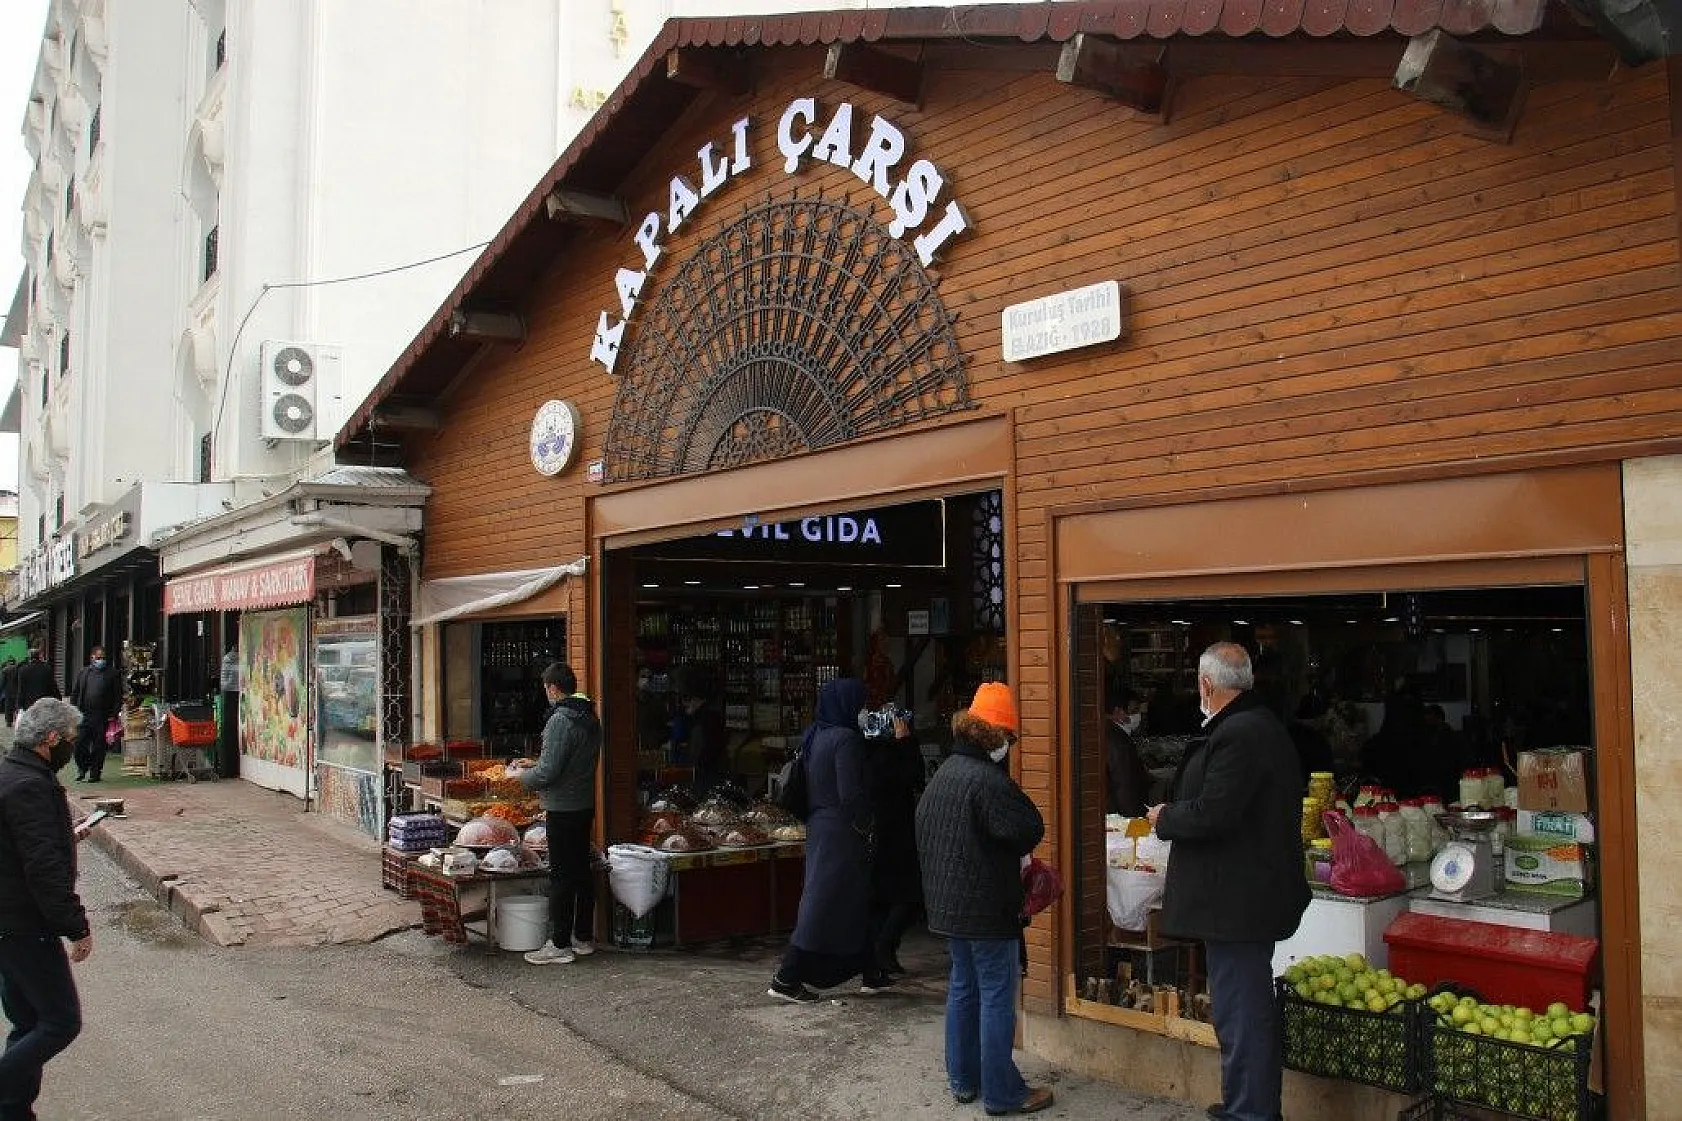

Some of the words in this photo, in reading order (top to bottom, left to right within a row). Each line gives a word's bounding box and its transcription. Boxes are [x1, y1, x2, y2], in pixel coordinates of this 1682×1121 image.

[589, 117, 752, 374] KAPALI
[777, 97, 967, 268] ÇARŞI
[1068, 286, 1111, 313] Tarihi
[800, 515, 883, 545] GIDA
